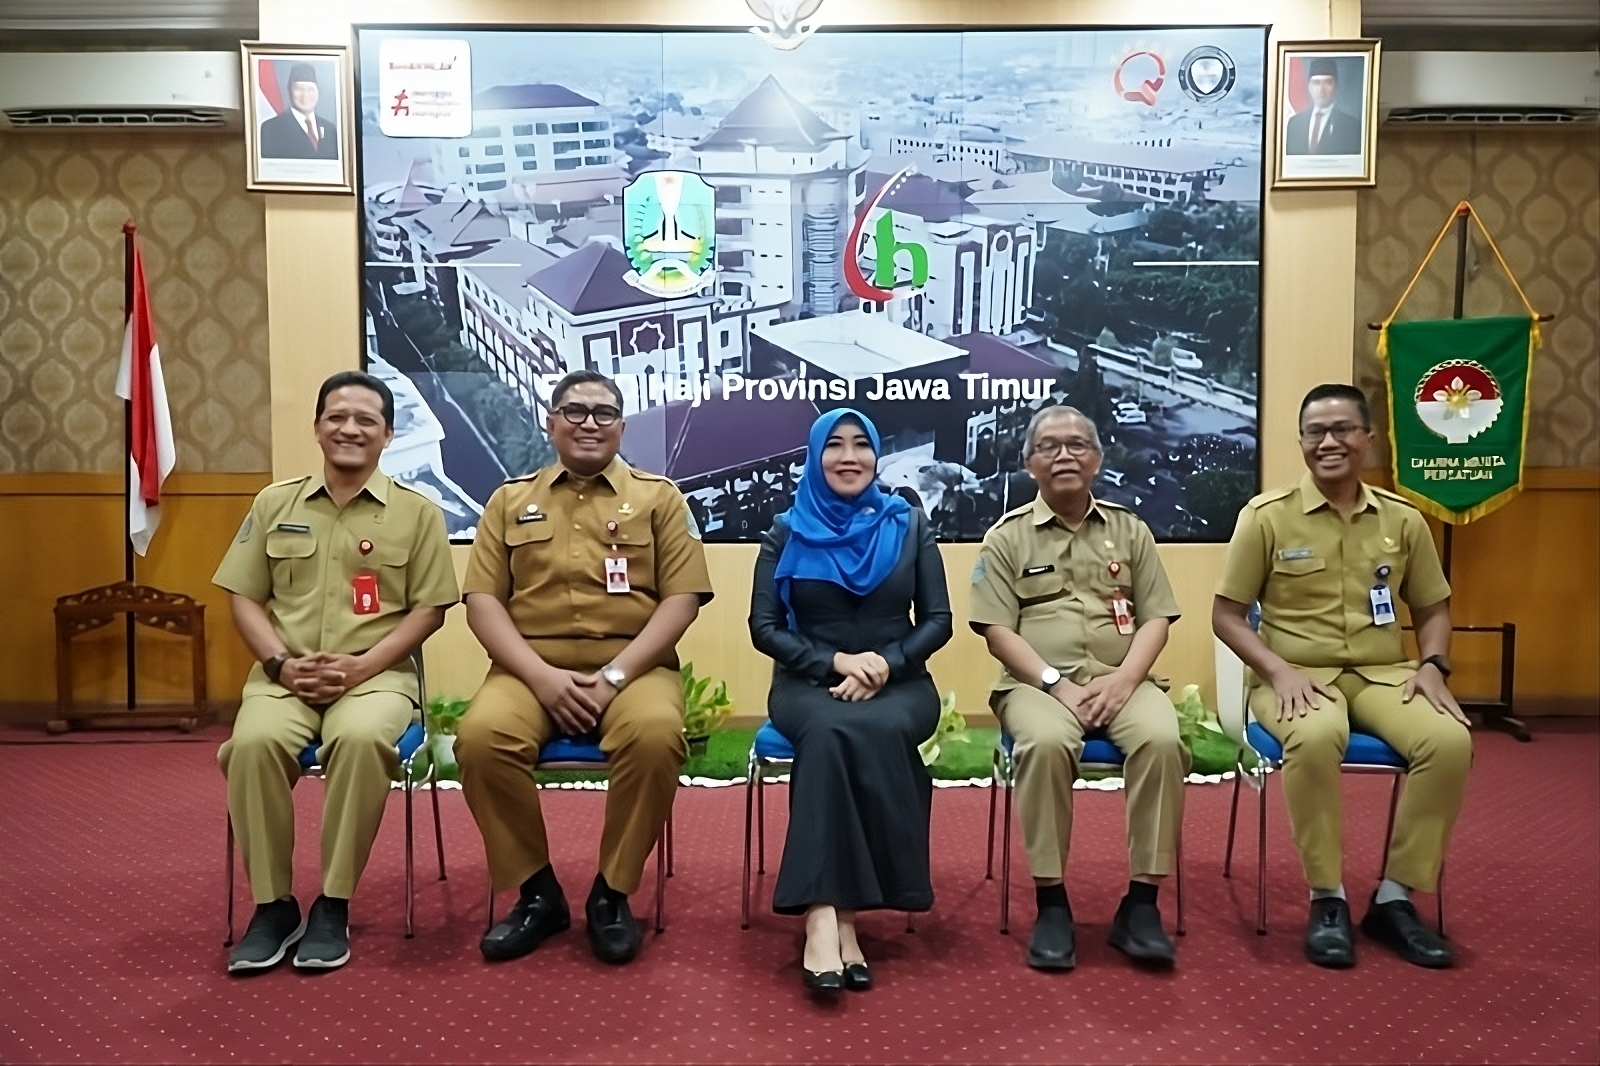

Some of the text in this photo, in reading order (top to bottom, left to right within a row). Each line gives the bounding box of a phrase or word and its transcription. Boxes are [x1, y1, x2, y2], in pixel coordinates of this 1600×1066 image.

[722, 370, 856, 401] Provinsi
[866, 373, 951, 401] Jawa
[958, 372, 1056, 401] Timur
